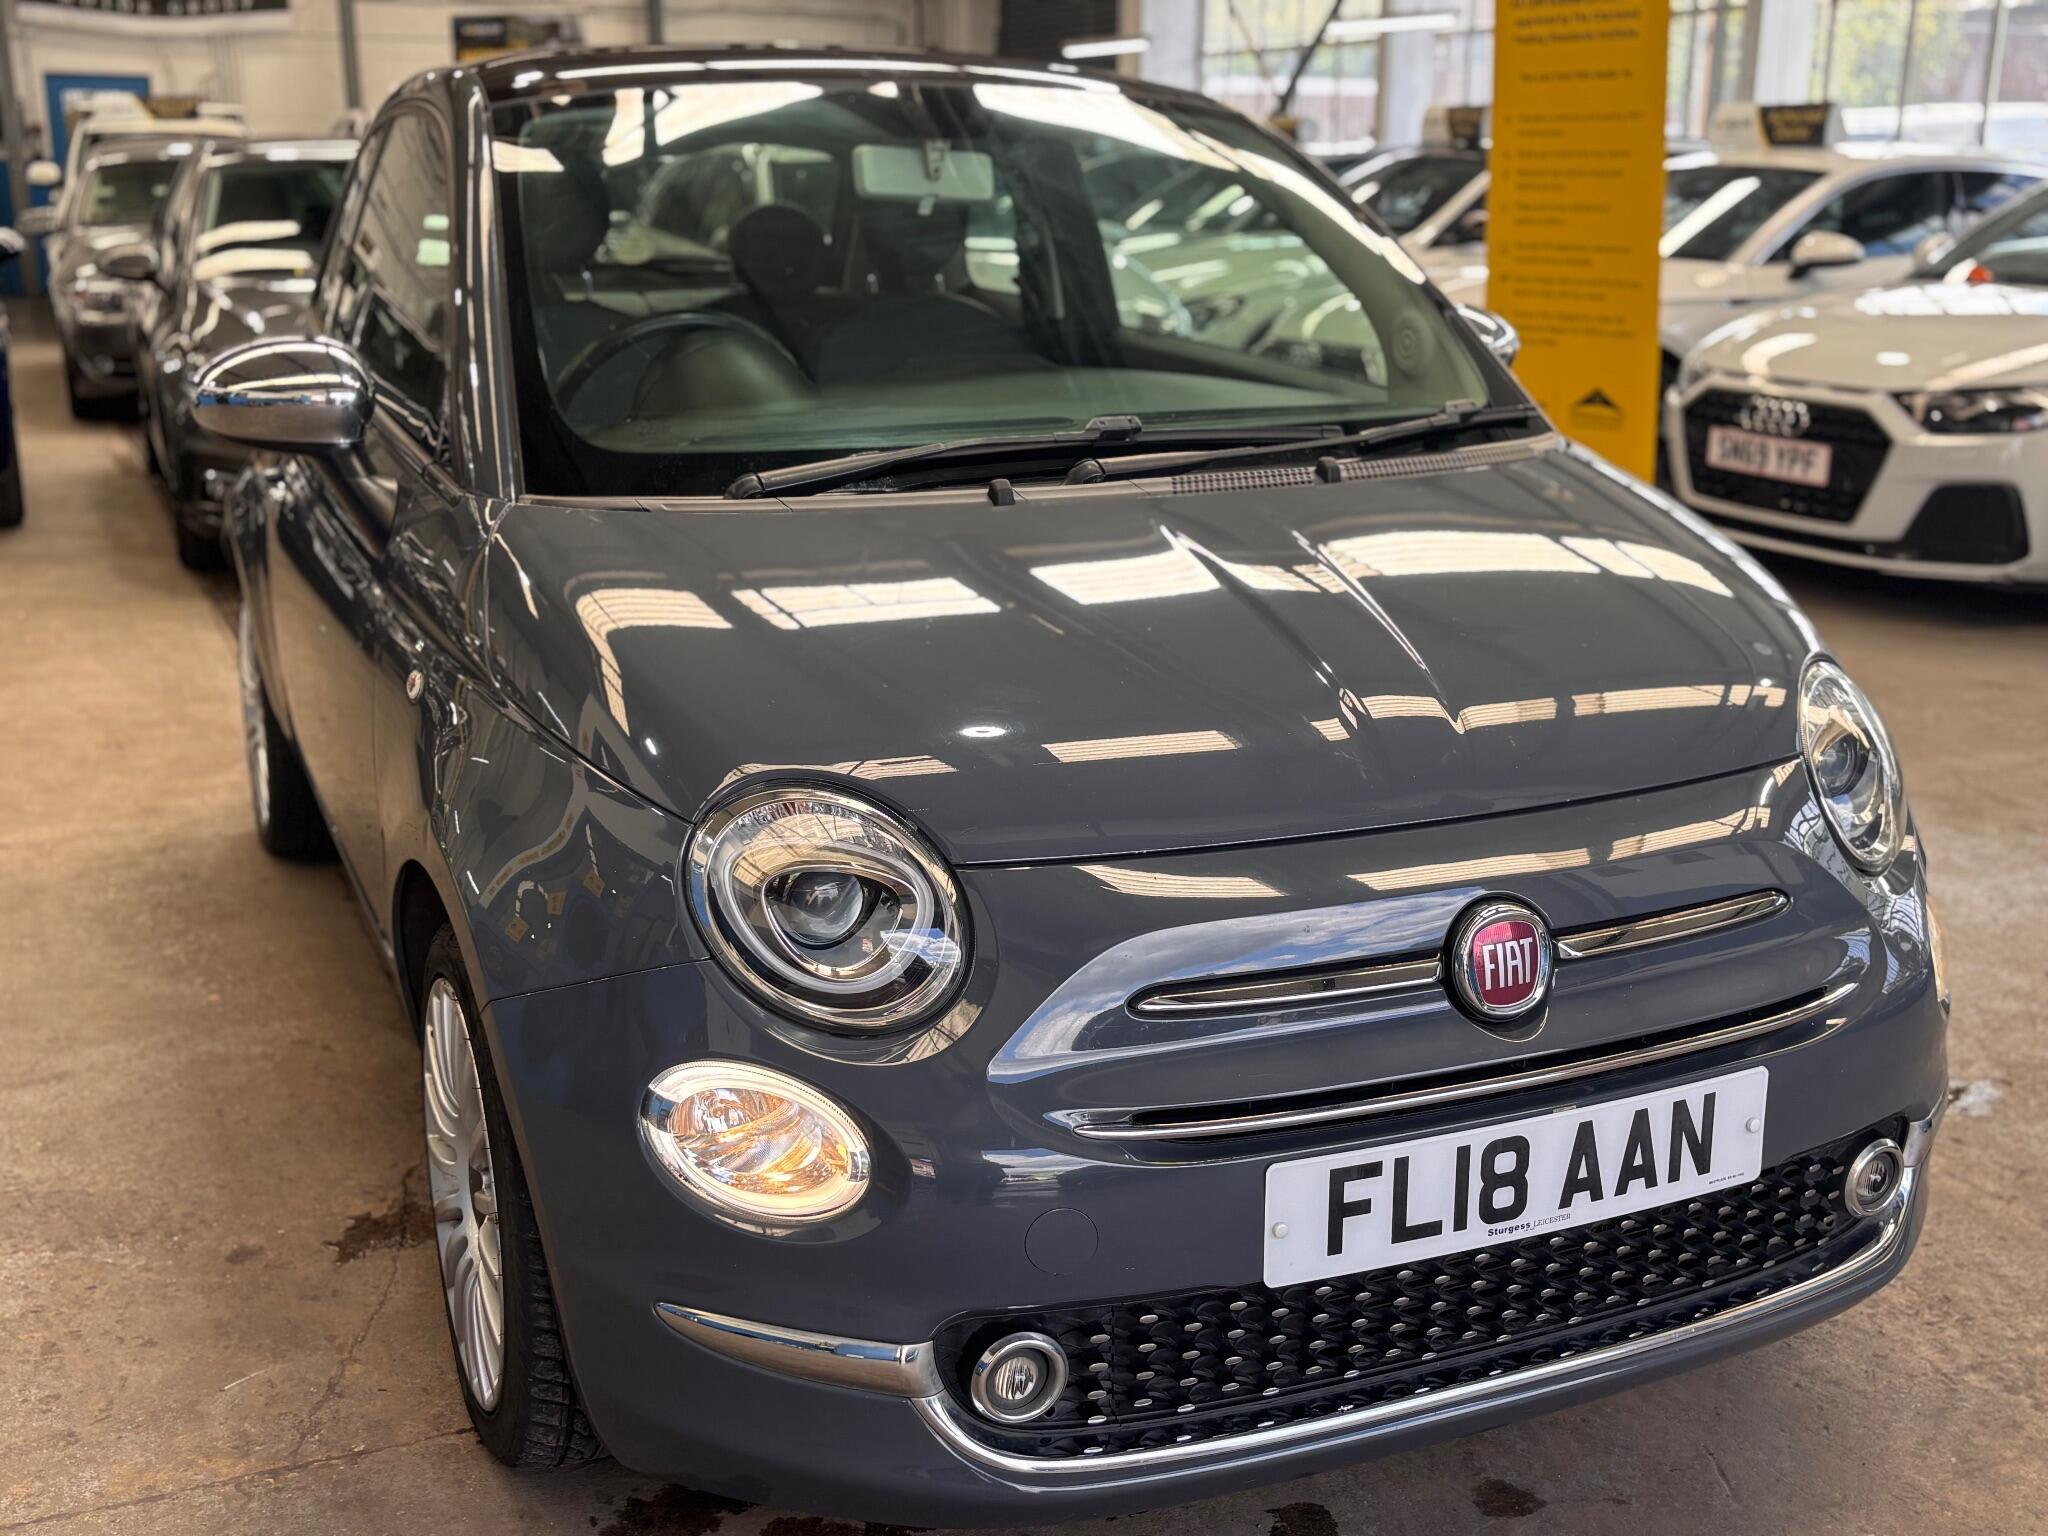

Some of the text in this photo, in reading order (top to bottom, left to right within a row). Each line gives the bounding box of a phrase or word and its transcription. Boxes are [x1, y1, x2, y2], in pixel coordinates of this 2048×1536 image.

[1482, 937, 1534, 991] FIAT
[1326, 1091, 1717, 1257] FL18 AAN
[1487, 1213, 1571, 1237] Sturgess LEICESTER
